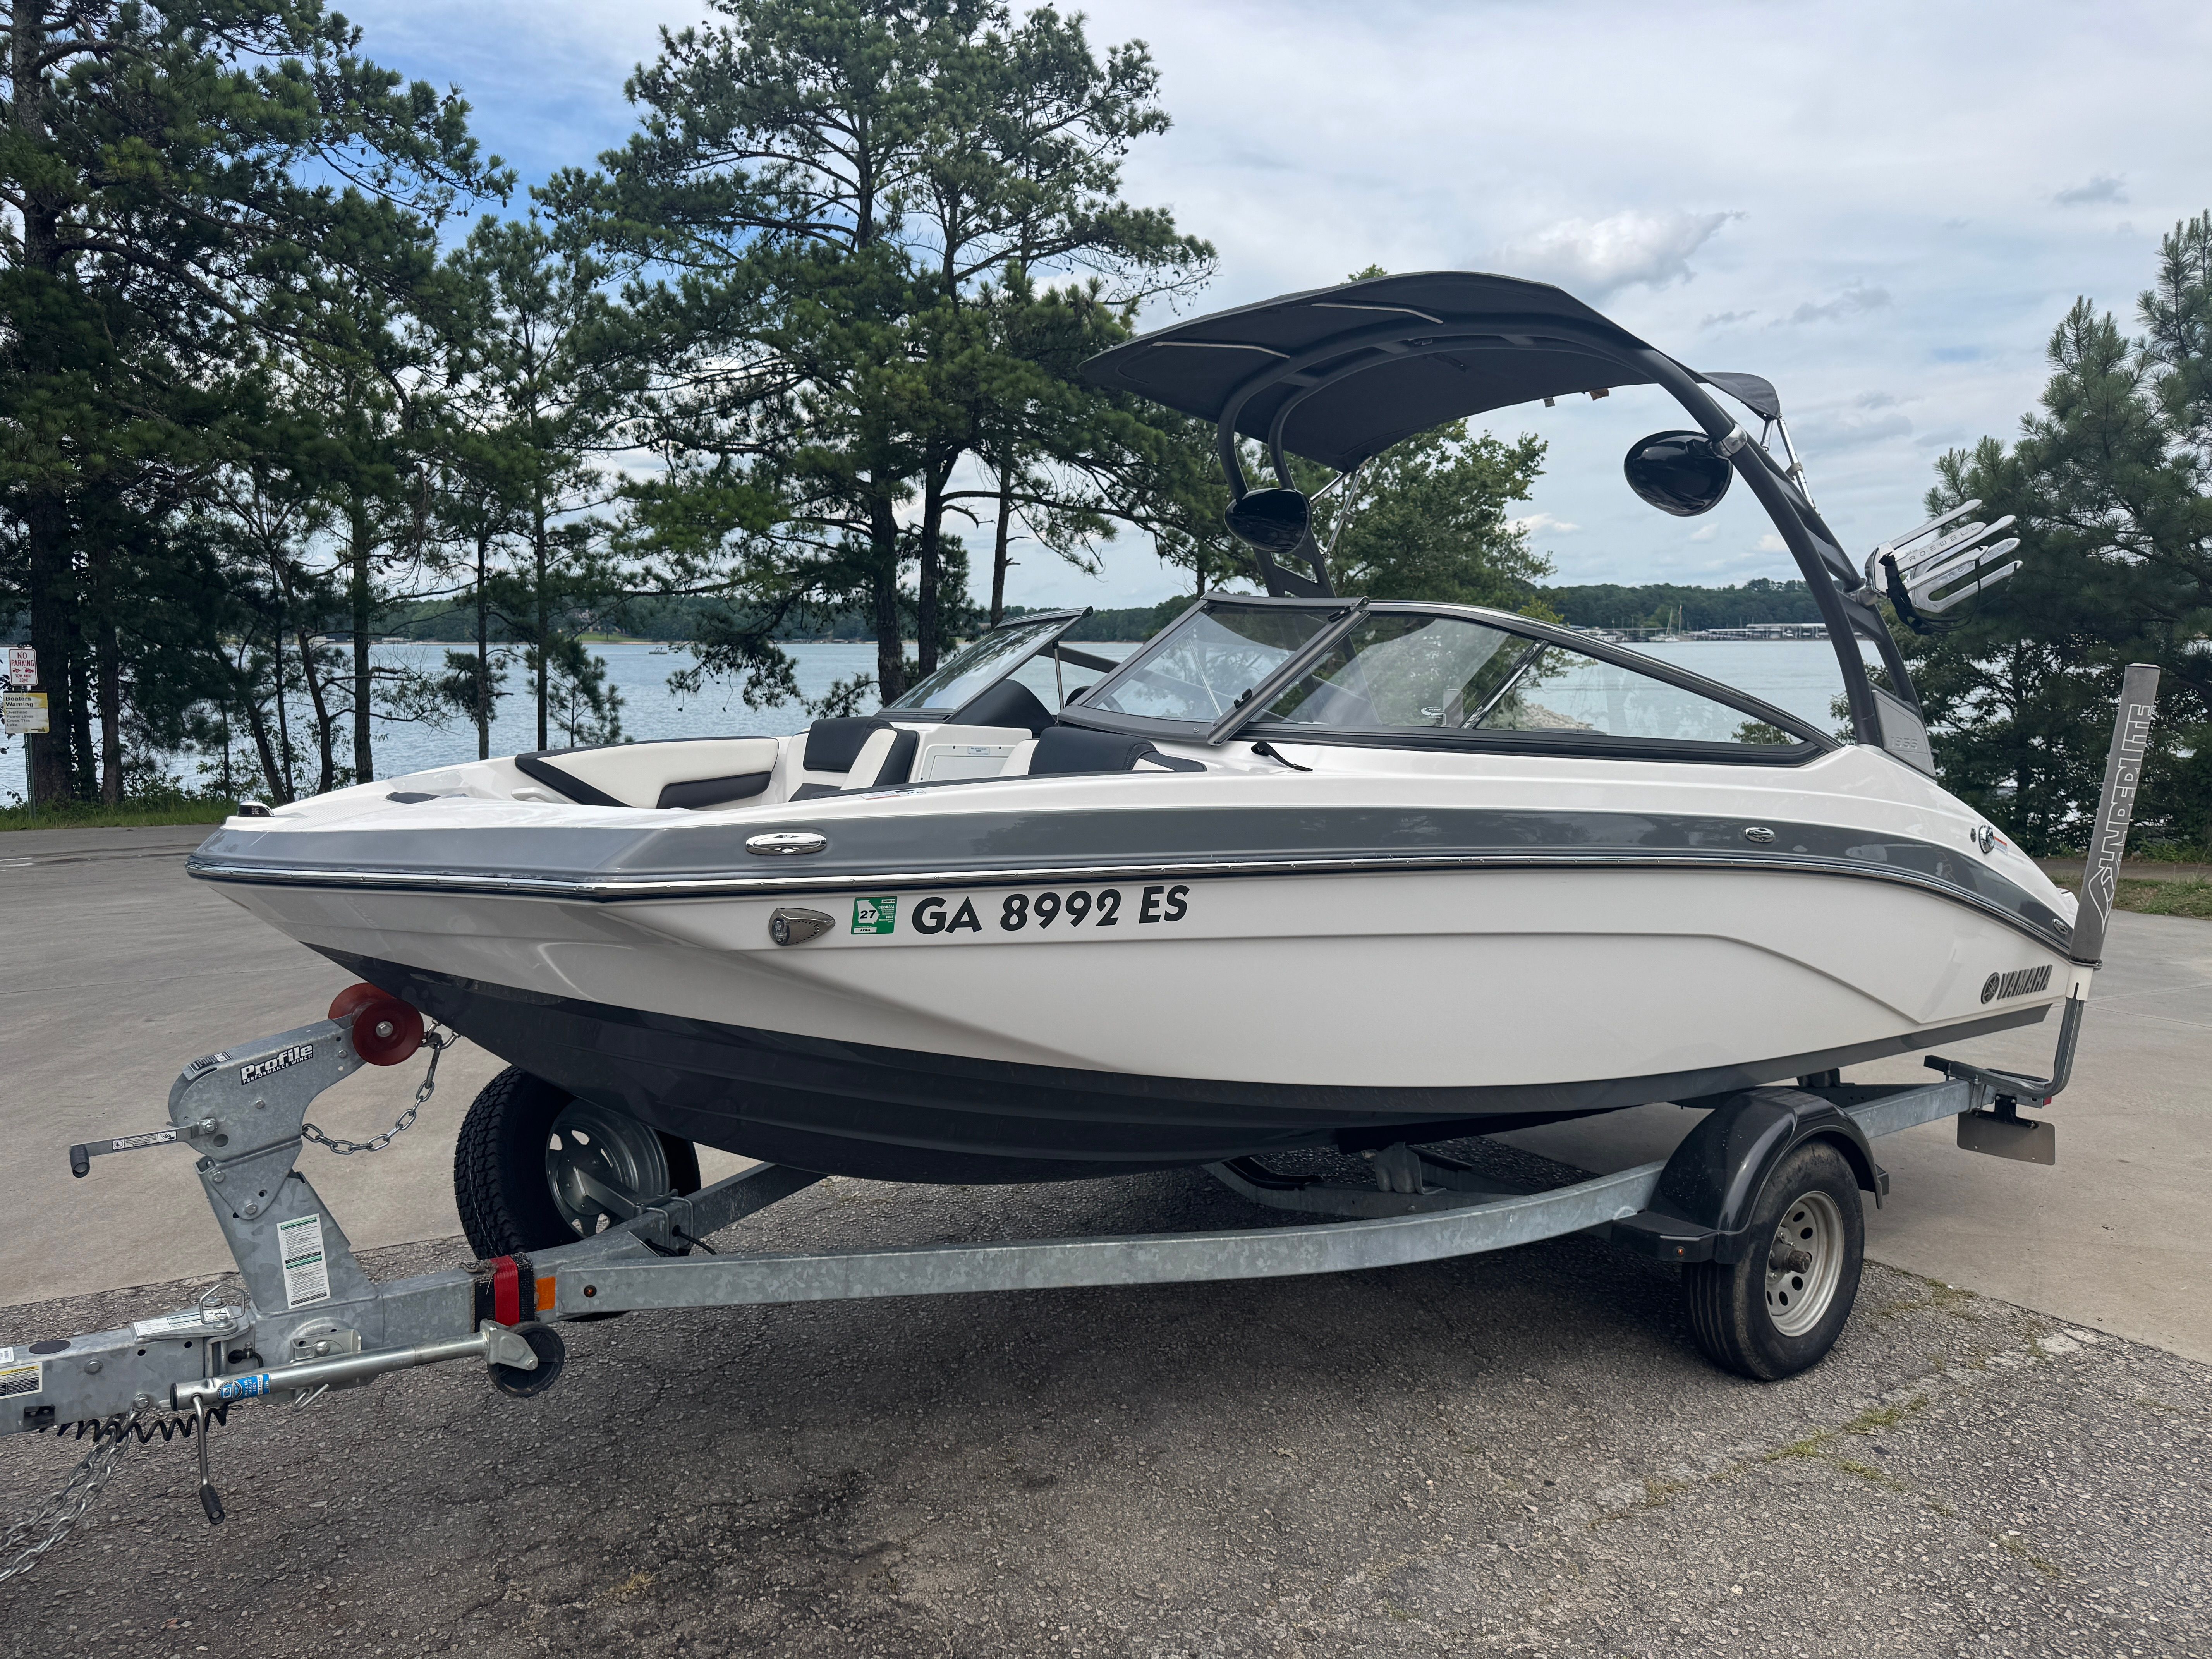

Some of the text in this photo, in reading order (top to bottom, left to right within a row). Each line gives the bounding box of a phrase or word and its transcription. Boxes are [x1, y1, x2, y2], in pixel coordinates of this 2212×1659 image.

[1909, 526, 1978, 562] ROSWELL
[860, 910, 876, 919] 27
[912, 885, 1190, 934] GA 8992 ES
[1997, 964, 2052, 1000] YAMAHA
[241, 1045, 313, 1080] Profile
[243, 1053, 312, 1084] PERFORMANCE WINCH
